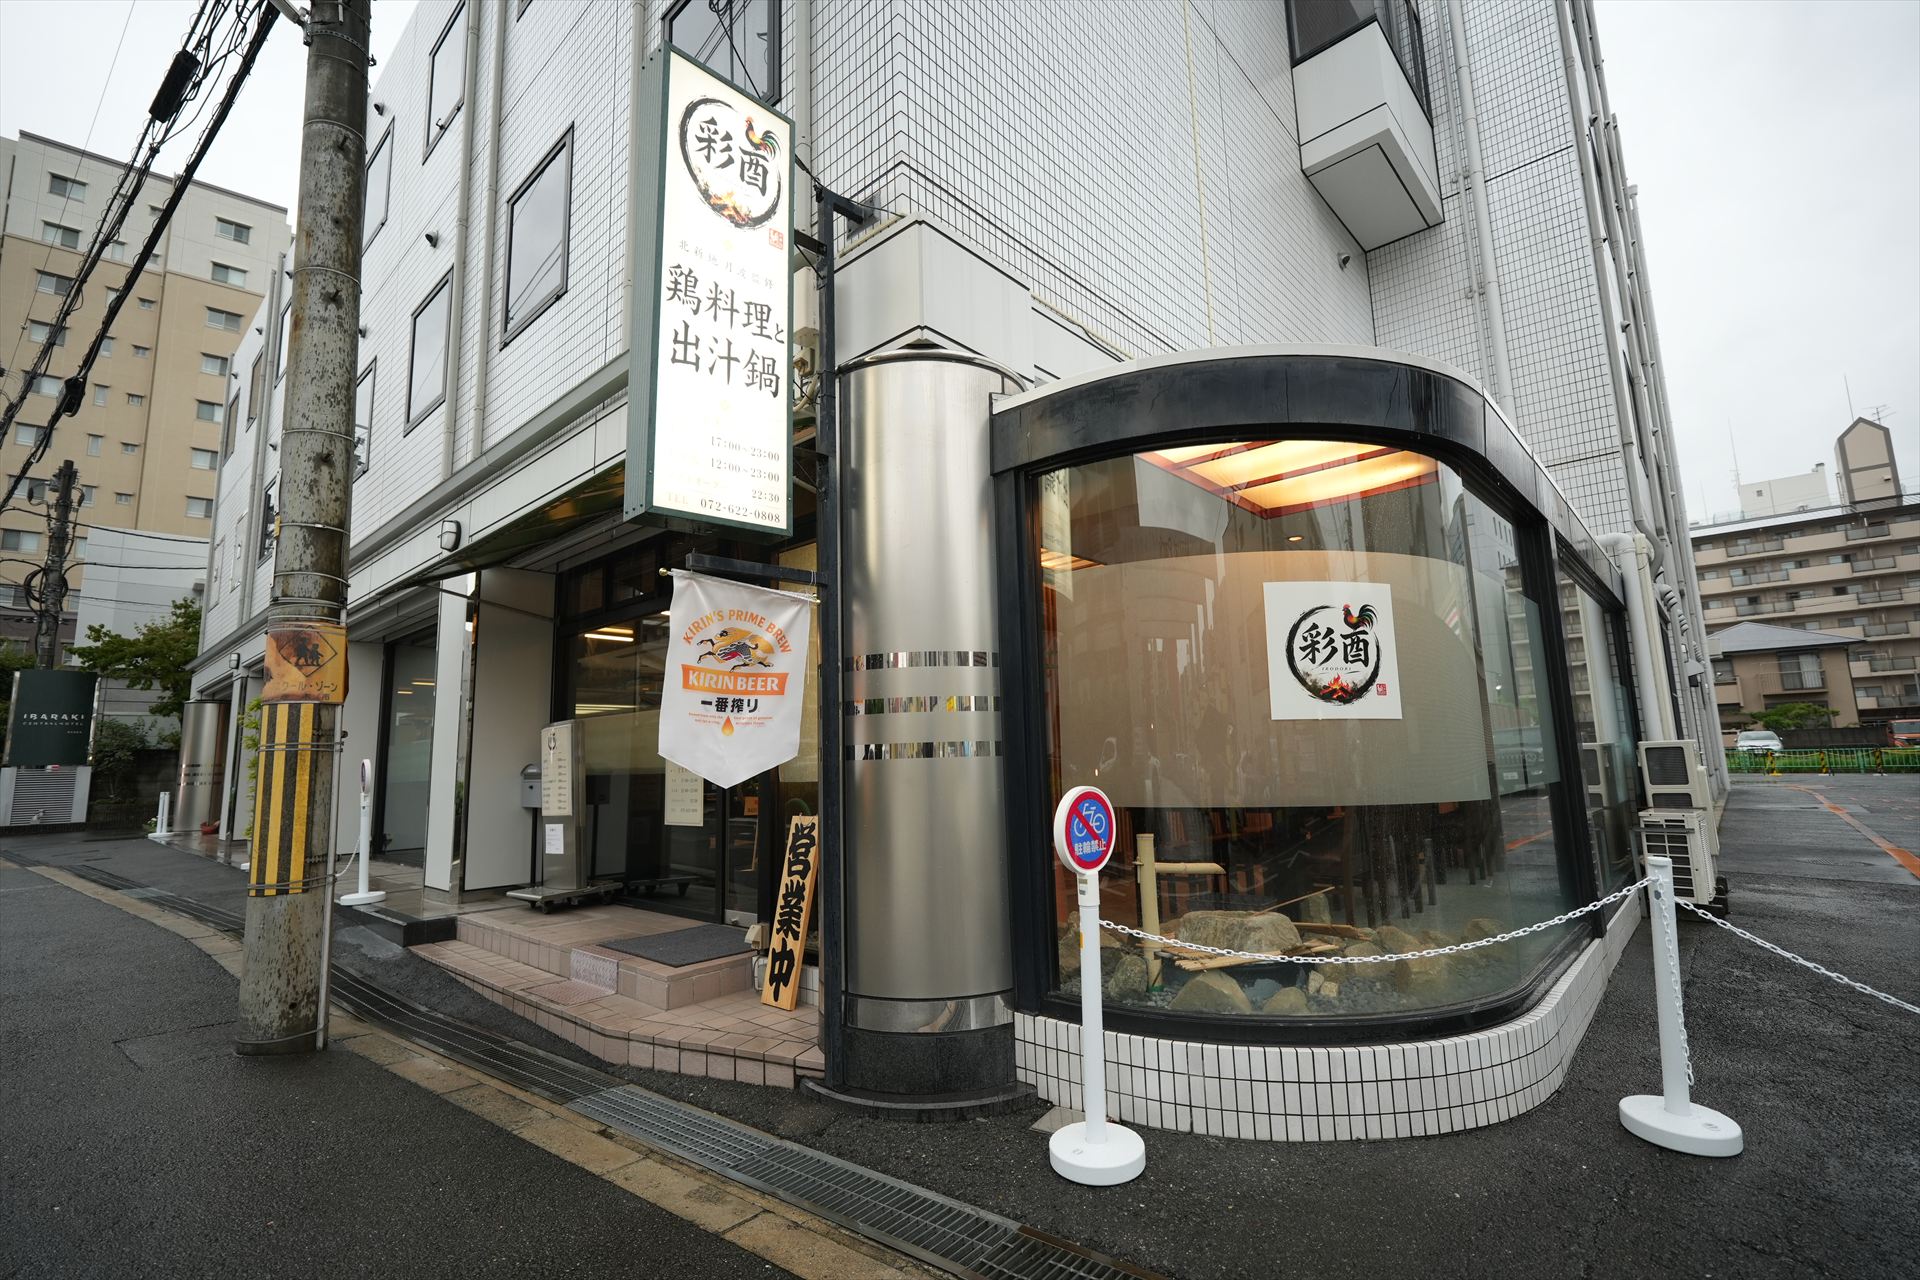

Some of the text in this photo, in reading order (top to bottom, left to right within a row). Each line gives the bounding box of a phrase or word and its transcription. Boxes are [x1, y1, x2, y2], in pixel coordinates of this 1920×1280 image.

[694, 116, 770, 197] 彩酉
[666, 264, 785, 344] 鶏料理と
[670, 320, 781, 399] 出汁鍋
[700, 498, 781, 523] 072-622-0808
[752, 489, 780, 503] 22:30
[683, 609, 793, 654] KIRIN'S PRIME BREW
[1299, 622, 1370, 668] 彩酉
[688, 670, 780, 692] KIRIN BEER
[23, 713, 85, 721] IBARAKI
[701, 697, 759, 713] 一番搾り
[1074, 838, 1107, 856] 駐輪禁止
[768, 822, 817, 1003] 営業中
